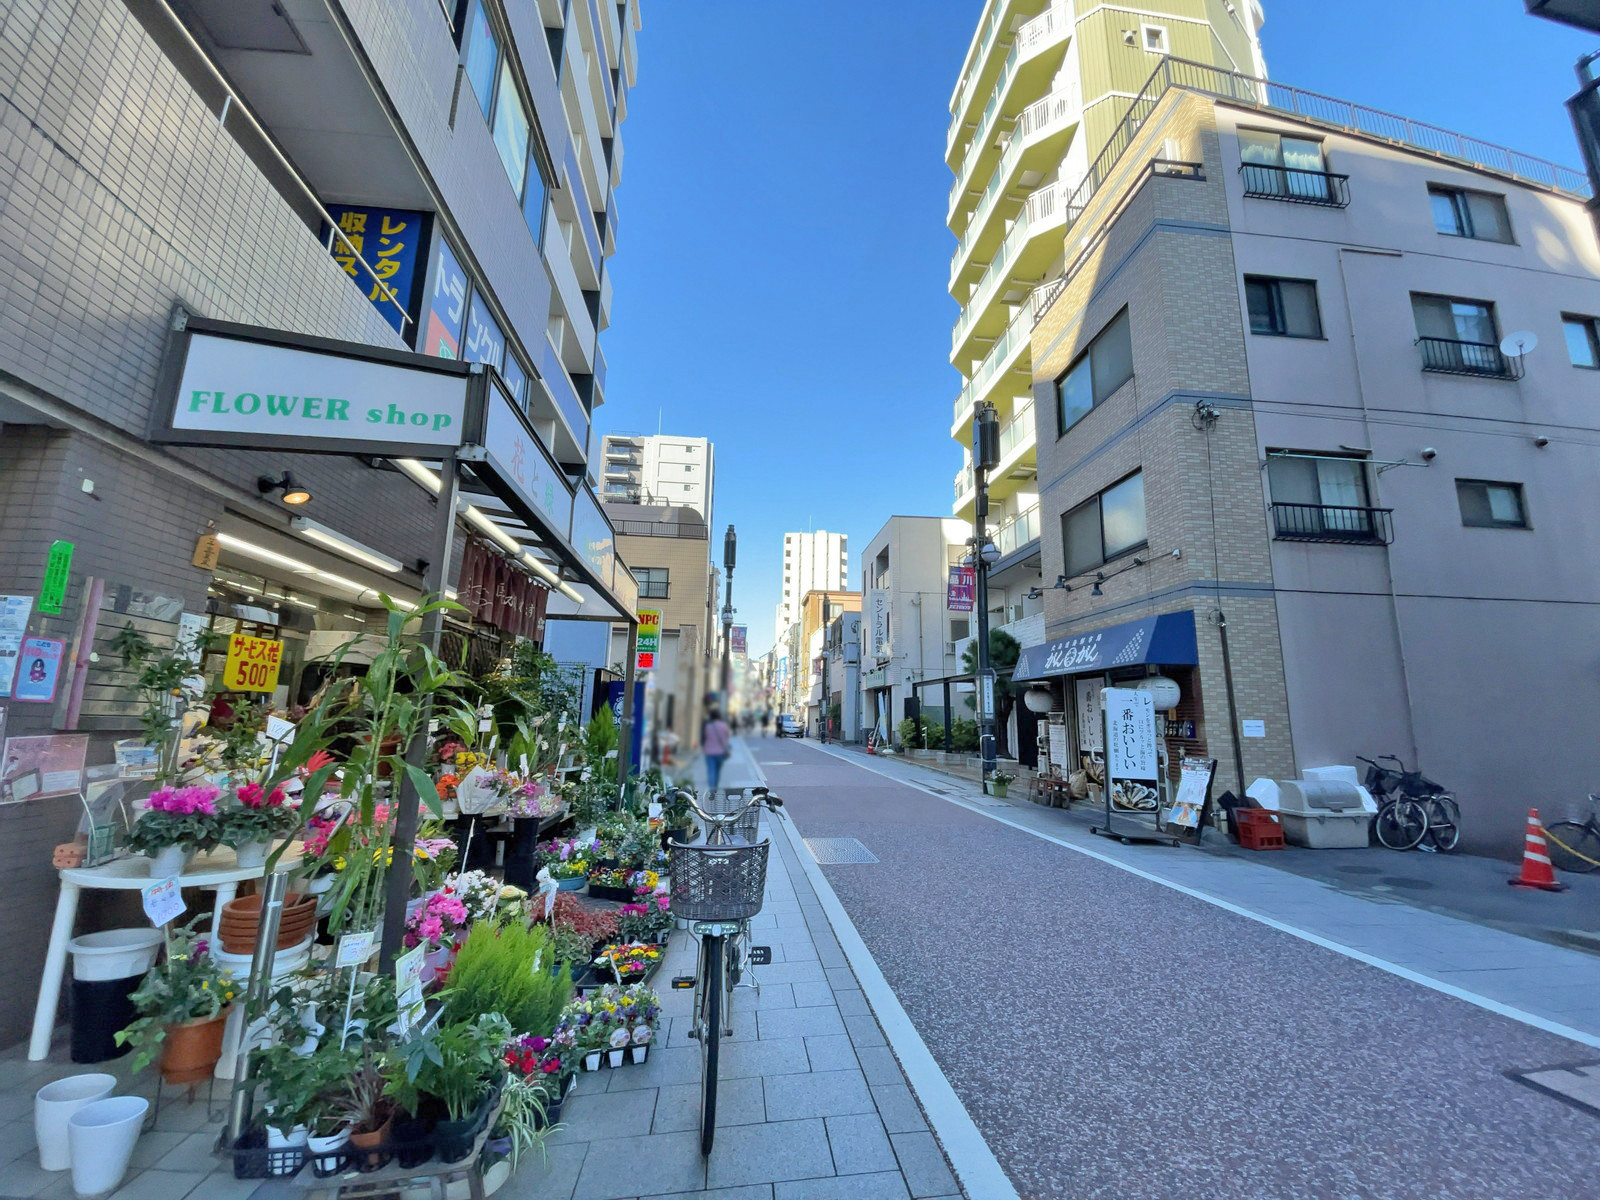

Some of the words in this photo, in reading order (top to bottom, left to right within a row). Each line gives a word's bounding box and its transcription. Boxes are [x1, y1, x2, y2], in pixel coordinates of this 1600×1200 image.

[369, 216, 406, 301] レンタル
[188, 391, 350, 421] FLOWER
[366, 404, 451, 431] shop
[637, 614, 659, 625] NPC
[234, 637, 280, 663] サービス花
[637, 638, 657, 646] 24H
[1120, 699, 1136, 769] 一番おいしい
